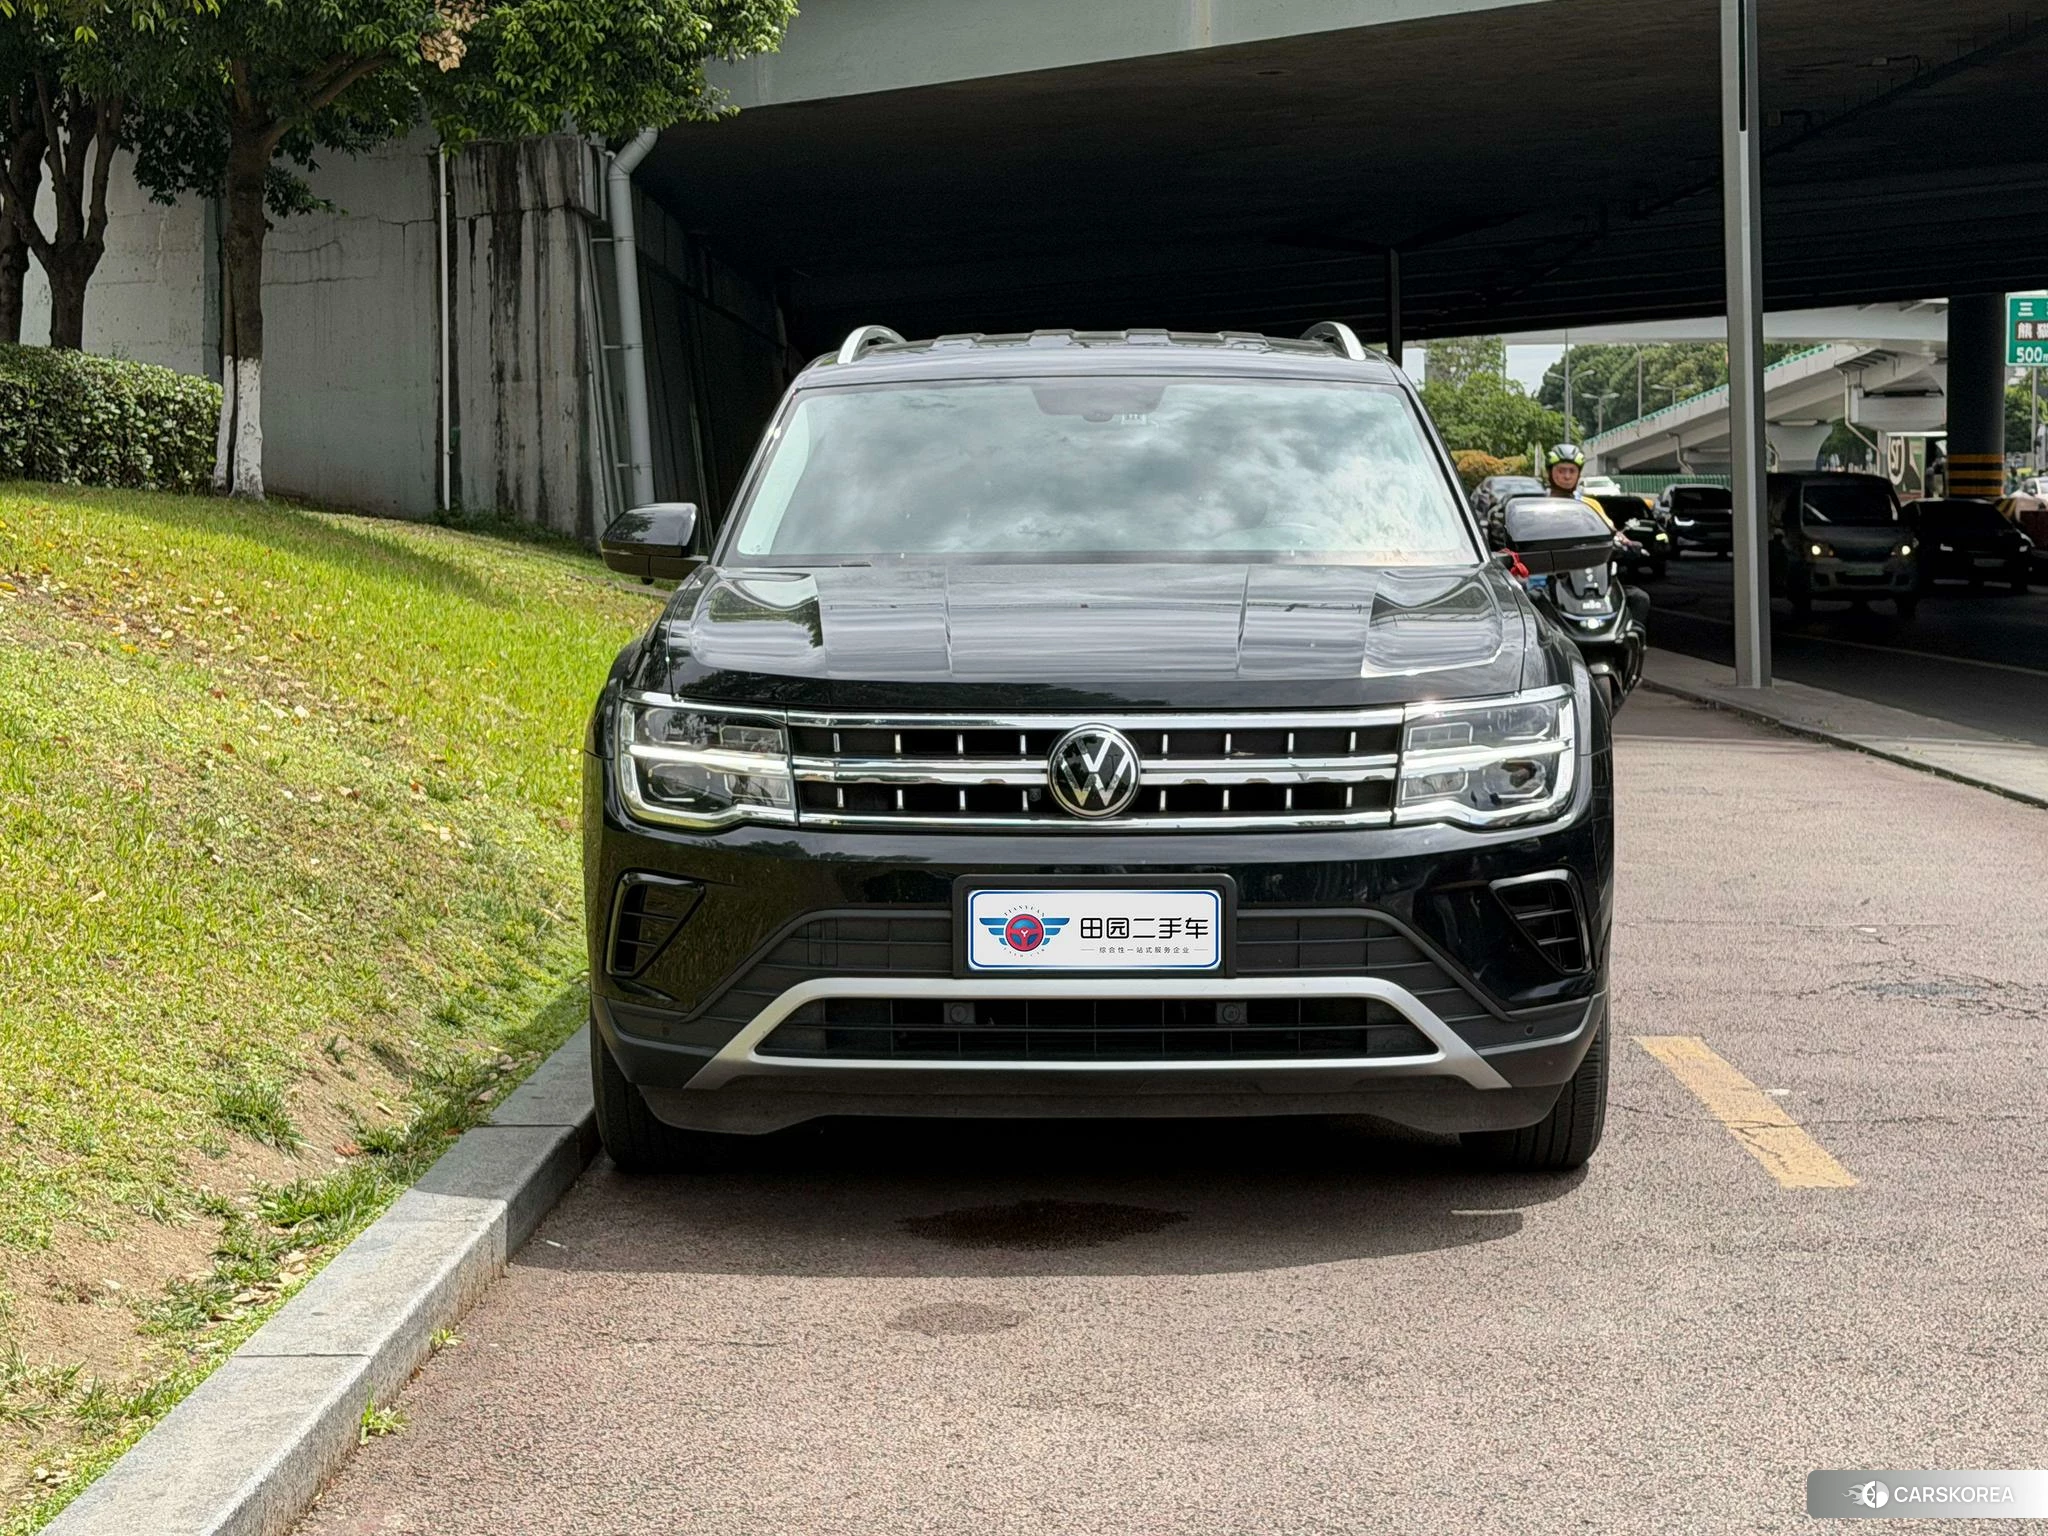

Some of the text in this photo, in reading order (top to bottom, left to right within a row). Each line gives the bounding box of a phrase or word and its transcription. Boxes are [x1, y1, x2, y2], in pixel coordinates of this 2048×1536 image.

[1080, 917, 1209, 939] 田园二手车
[1098, 946, 1191, 955] 综合性一站式服务企业
